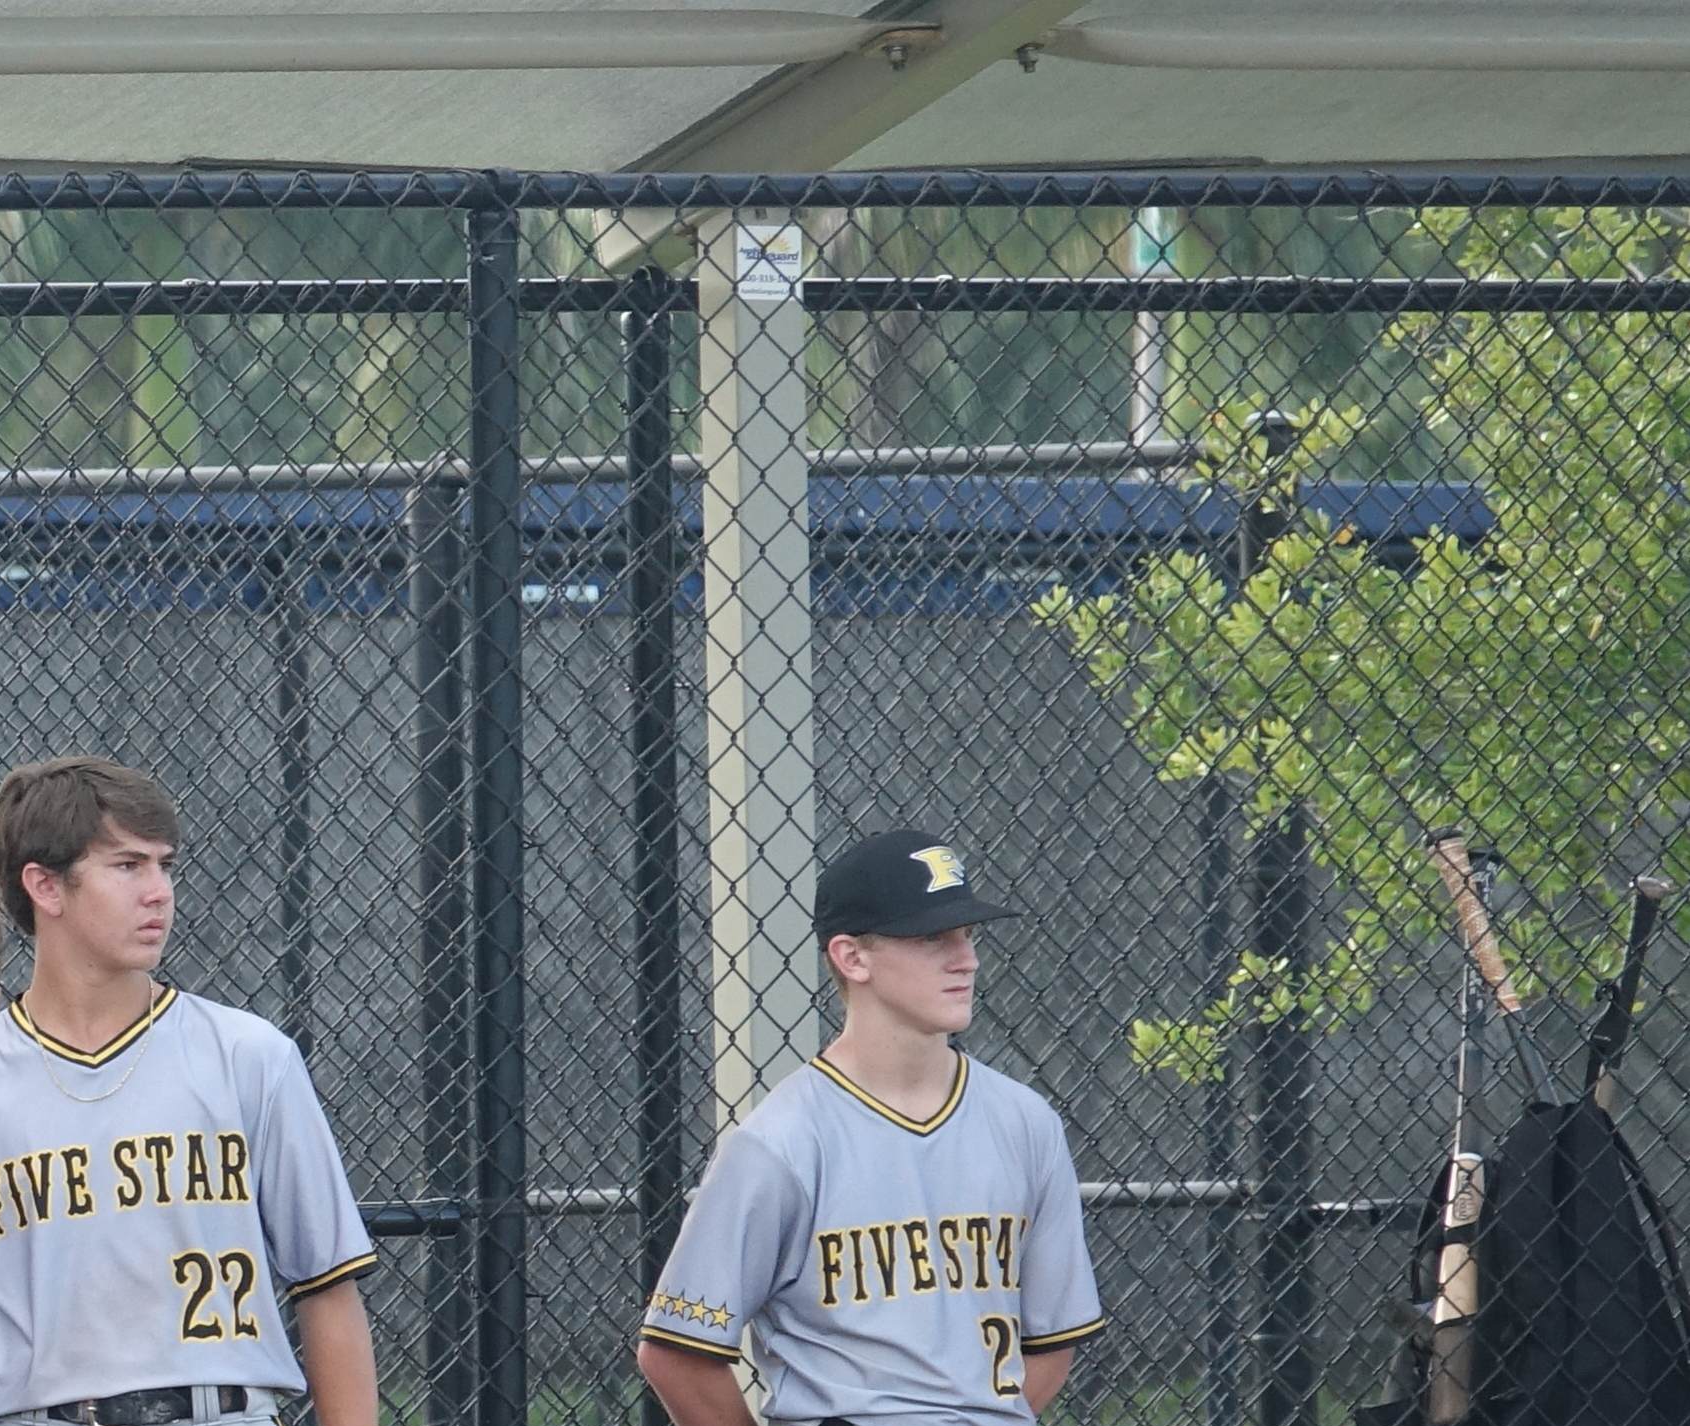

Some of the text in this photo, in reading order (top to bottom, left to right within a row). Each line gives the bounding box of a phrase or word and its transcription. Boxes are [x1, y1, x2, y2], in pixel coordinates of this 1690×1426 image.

[114, 1131, 250, 1209] STAR
[173, 1248, 260, 1344] 22
[818, 1214, 1027, 1306] FIVE STA
[980, 1316, 1022, 1398] 2
